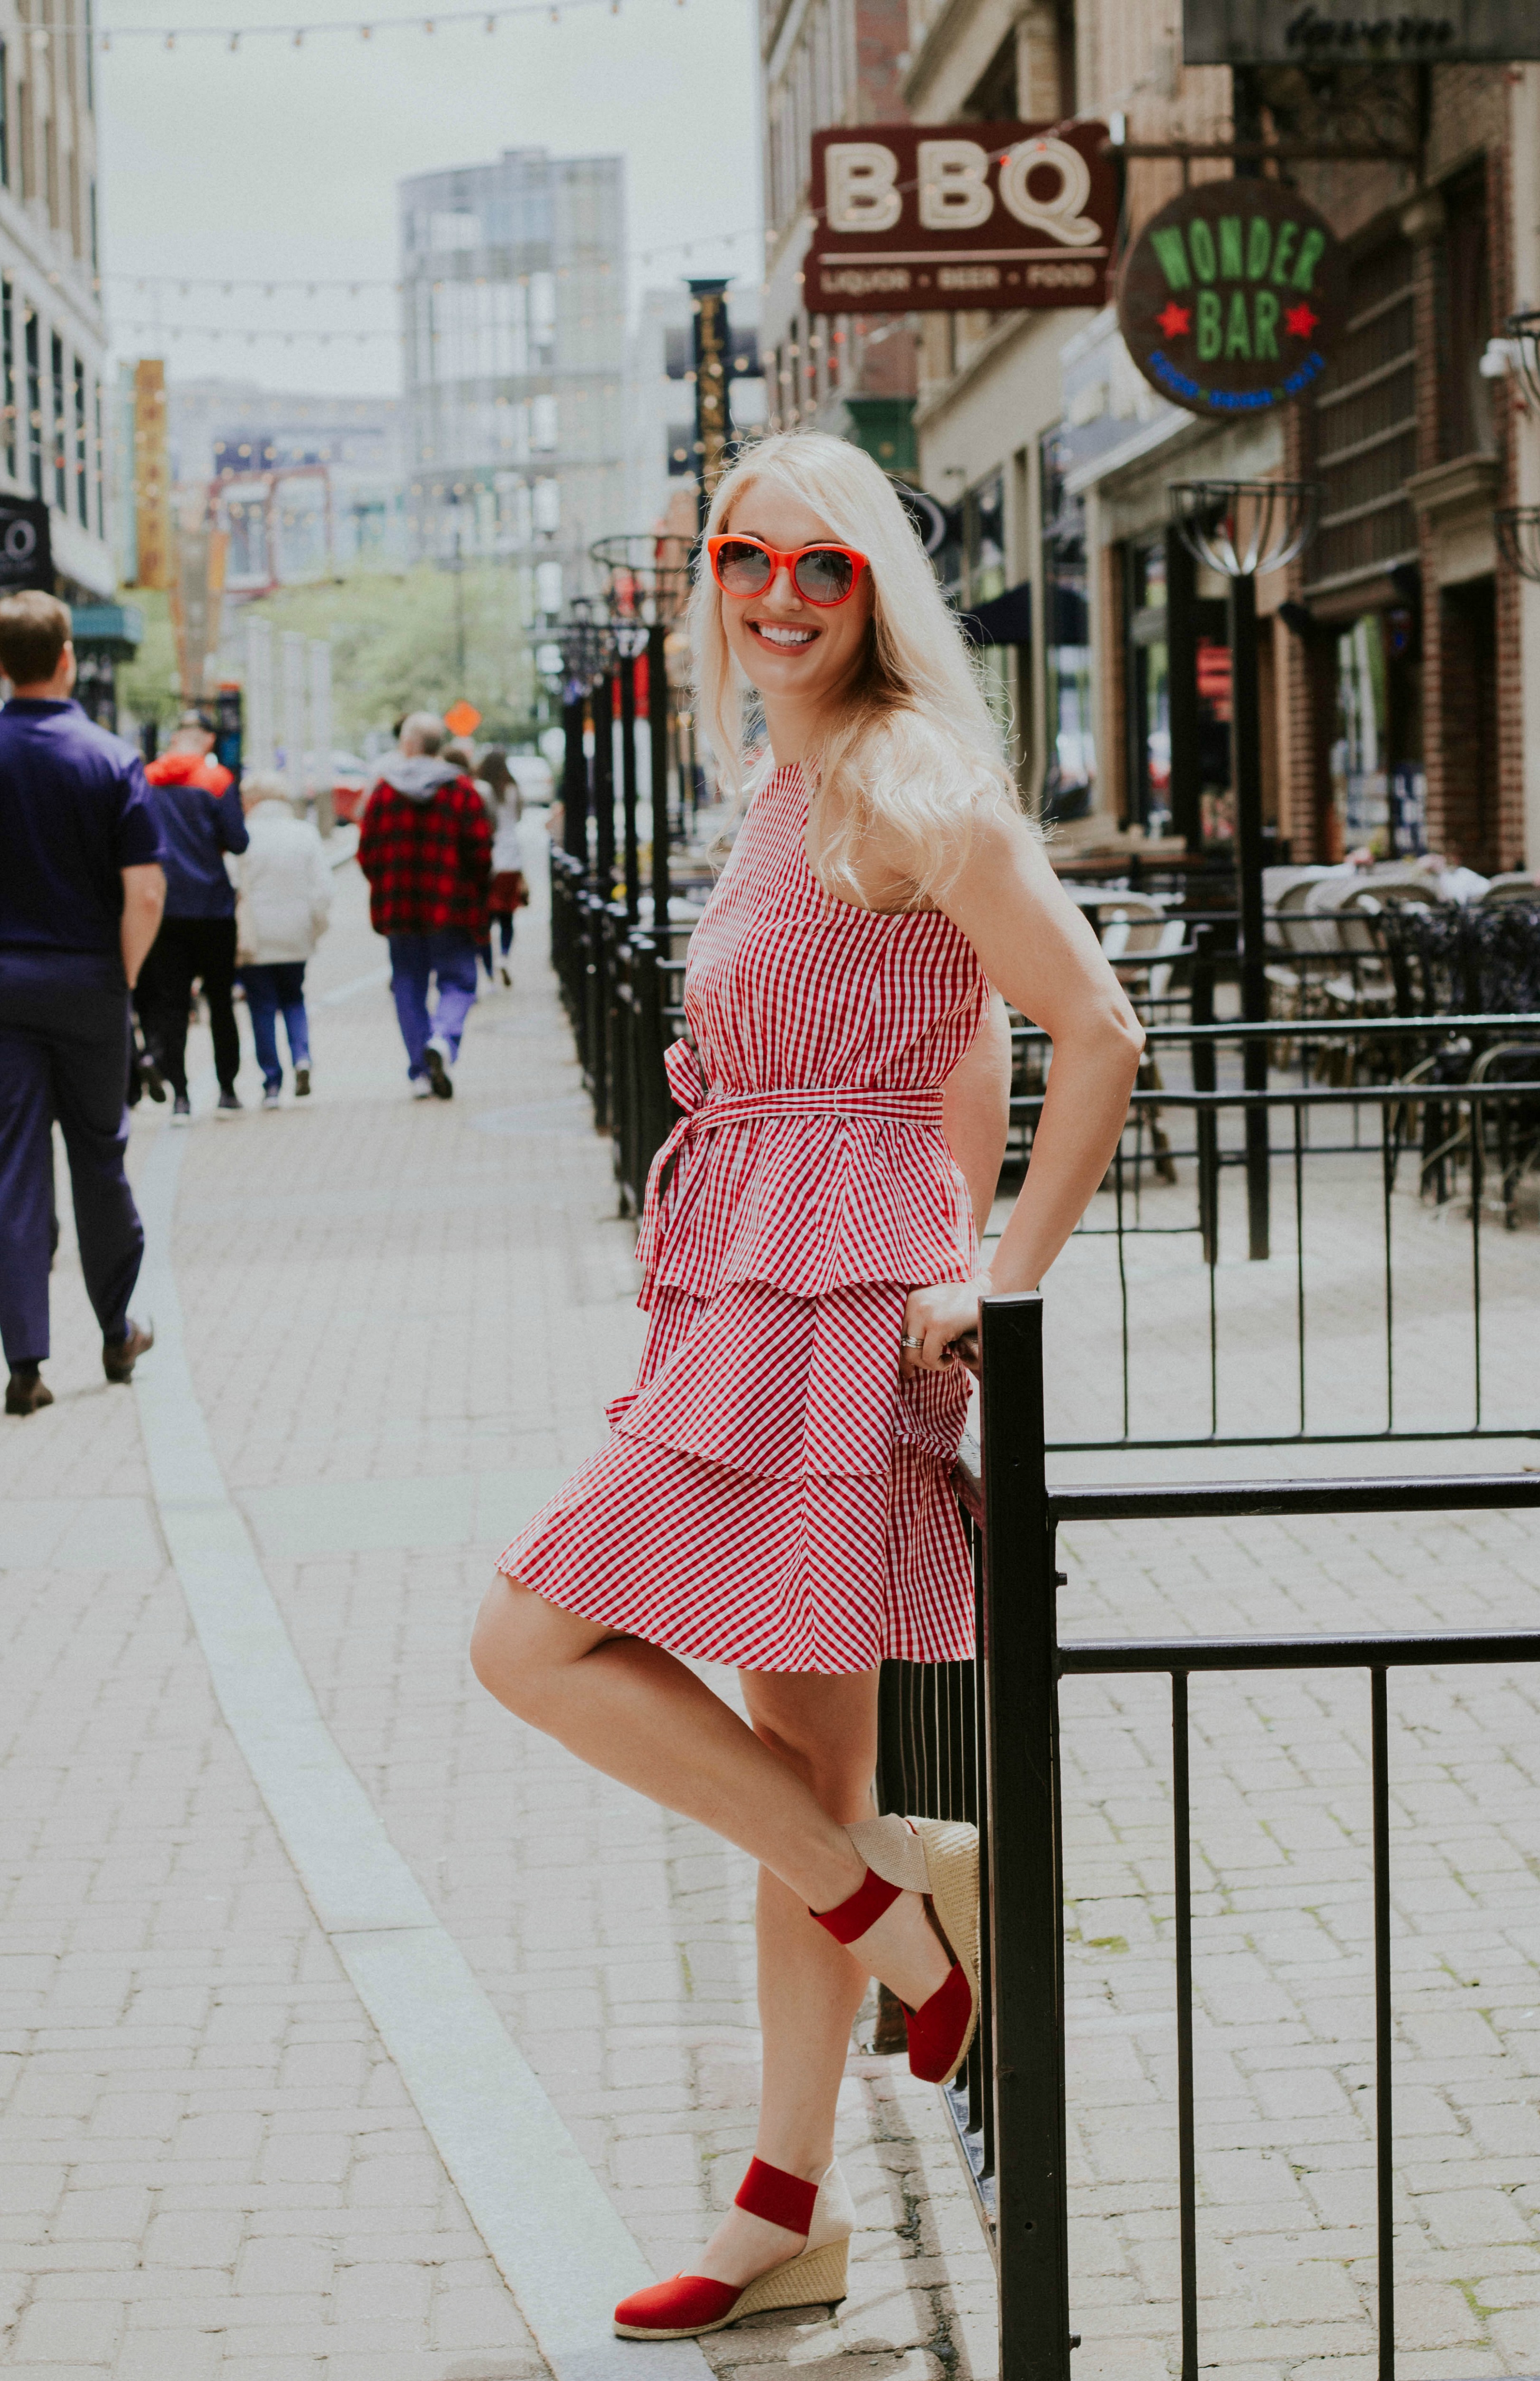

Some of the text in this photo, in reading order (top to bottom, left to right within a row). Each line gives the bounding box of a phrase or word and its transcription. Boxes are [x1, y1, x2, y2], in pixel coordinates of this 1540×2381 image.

[825, 137, 1102, 246] BBQ
[820, 264, 1096, 296] LIQUOR BEER FOOD
[1149, 215, 1326, 293] WONDER
[1196, 289, 1280, 361] BAR
